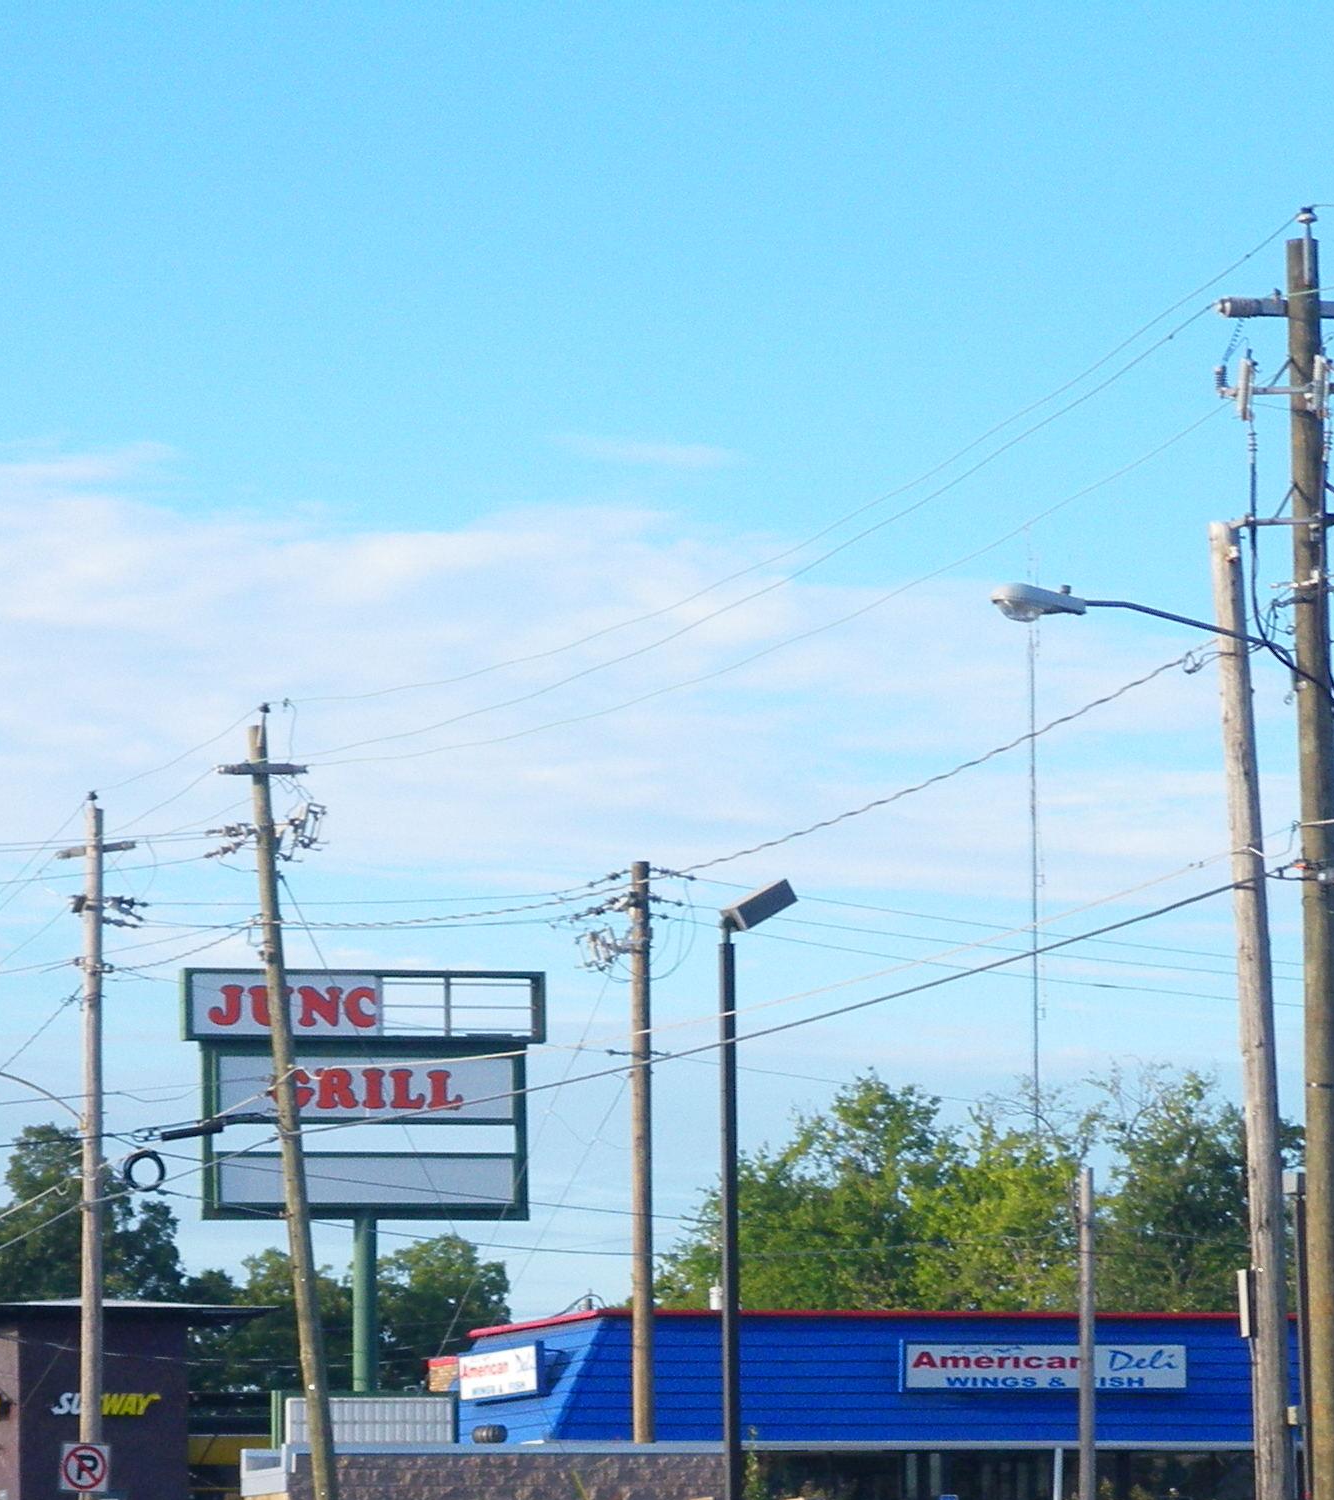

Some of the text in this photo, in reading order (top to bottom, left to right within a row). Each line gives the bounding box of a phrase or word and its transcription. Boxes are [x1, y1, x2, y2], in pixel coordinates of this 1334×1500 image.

[1108, 1349, 1179, 1371] Deli
[945, 1376, 1145, 1387] WINGS & ISH
[50, 1392, 161, 1415] SUWAY
